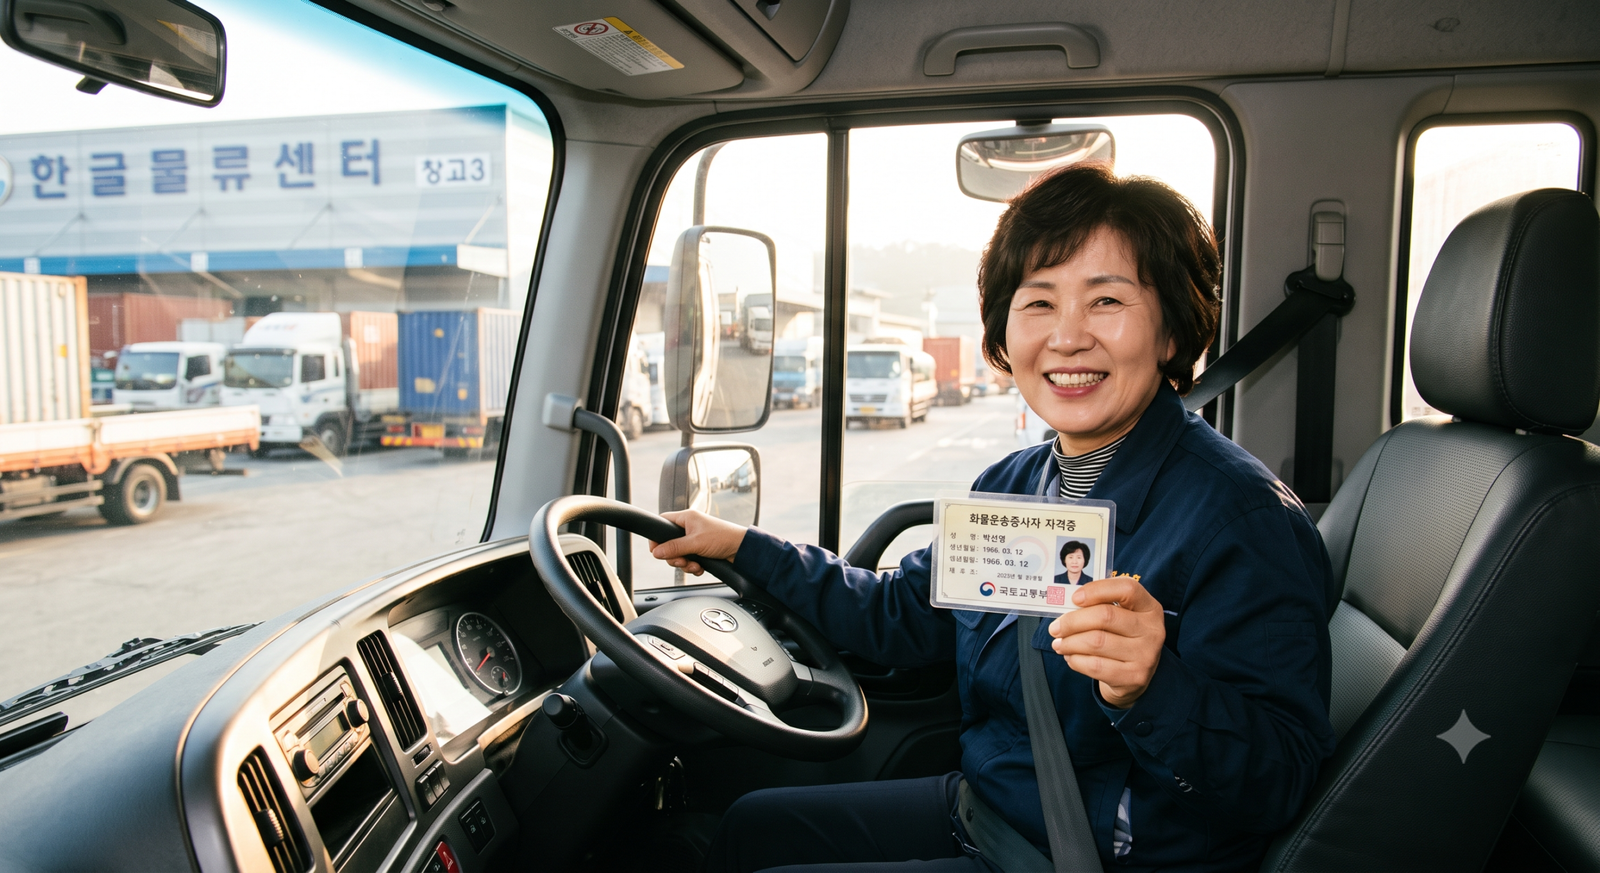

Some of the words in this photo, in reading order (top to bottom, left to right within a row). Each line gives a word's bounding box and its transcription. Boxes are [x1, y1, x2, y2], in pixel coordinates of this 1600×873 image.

[30, 139, 382, 200] 한글물류센터
[421, 158, 486, 185] 창고3
[1045, 518, 1077, 532] 자격증
[983, 533, 1006, 543] 박선영
[983, 546, 1000, 554] 1966.
[982, 557, 1002, 566] 1966.
[1005, 559, 1016, 567] 03.
[1019, 560, 1029, 568] 12
[999, 586, 1048, 599] 국토교통부
